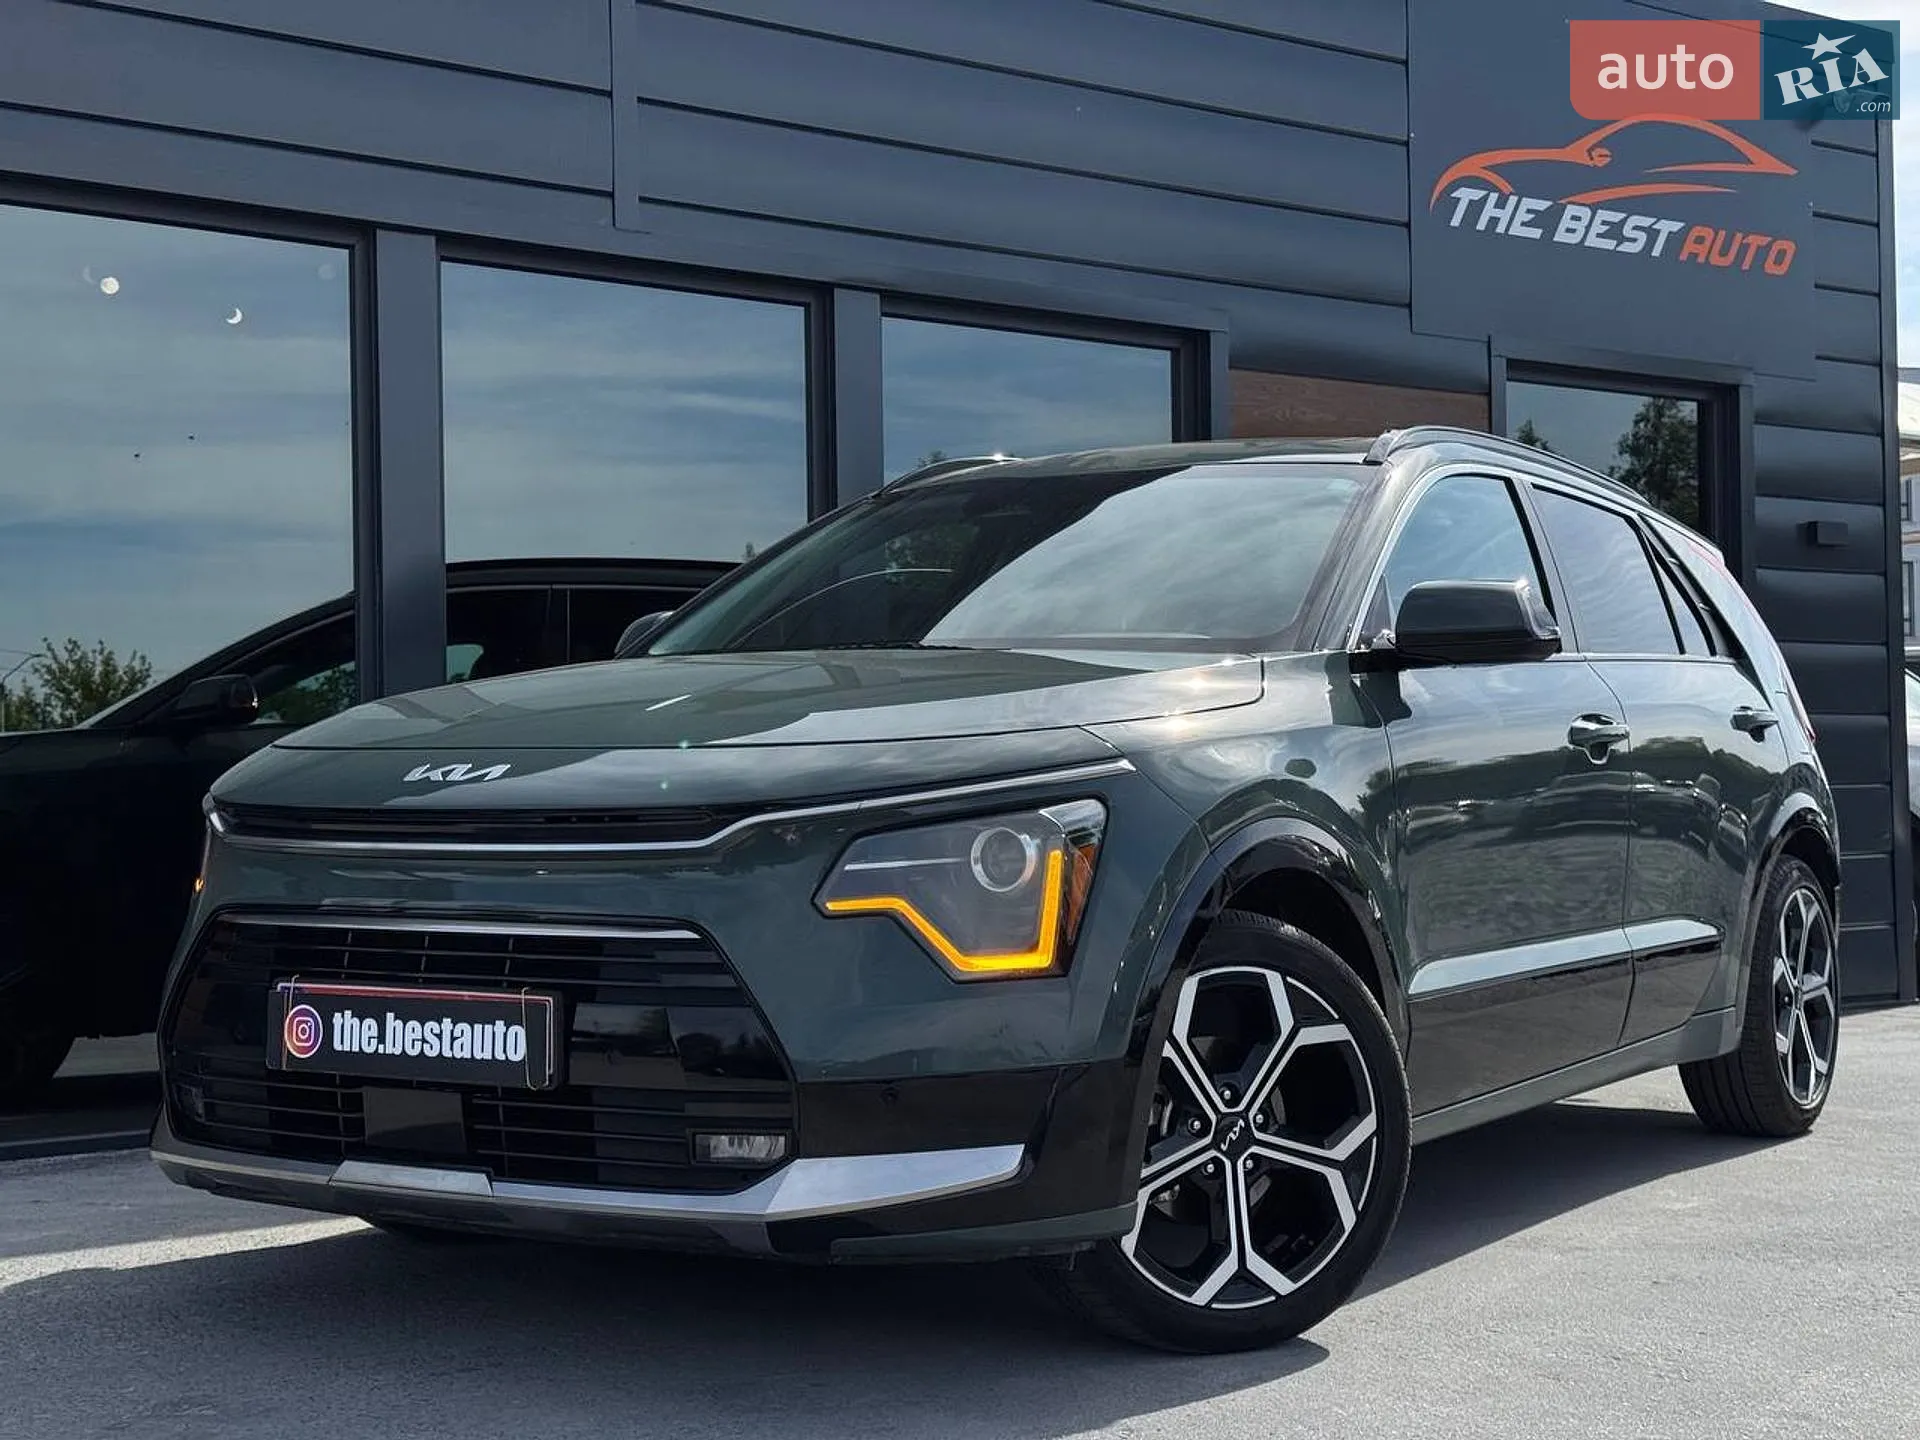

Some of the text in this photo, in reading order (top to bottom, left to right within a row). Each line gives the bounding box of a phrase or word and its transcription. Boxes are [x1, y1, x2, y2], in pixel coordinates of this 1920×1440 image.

[1449, 187, 1797, 277] THE BEST AUTO
[332, 1010, 526, 1061] the.bestauto
